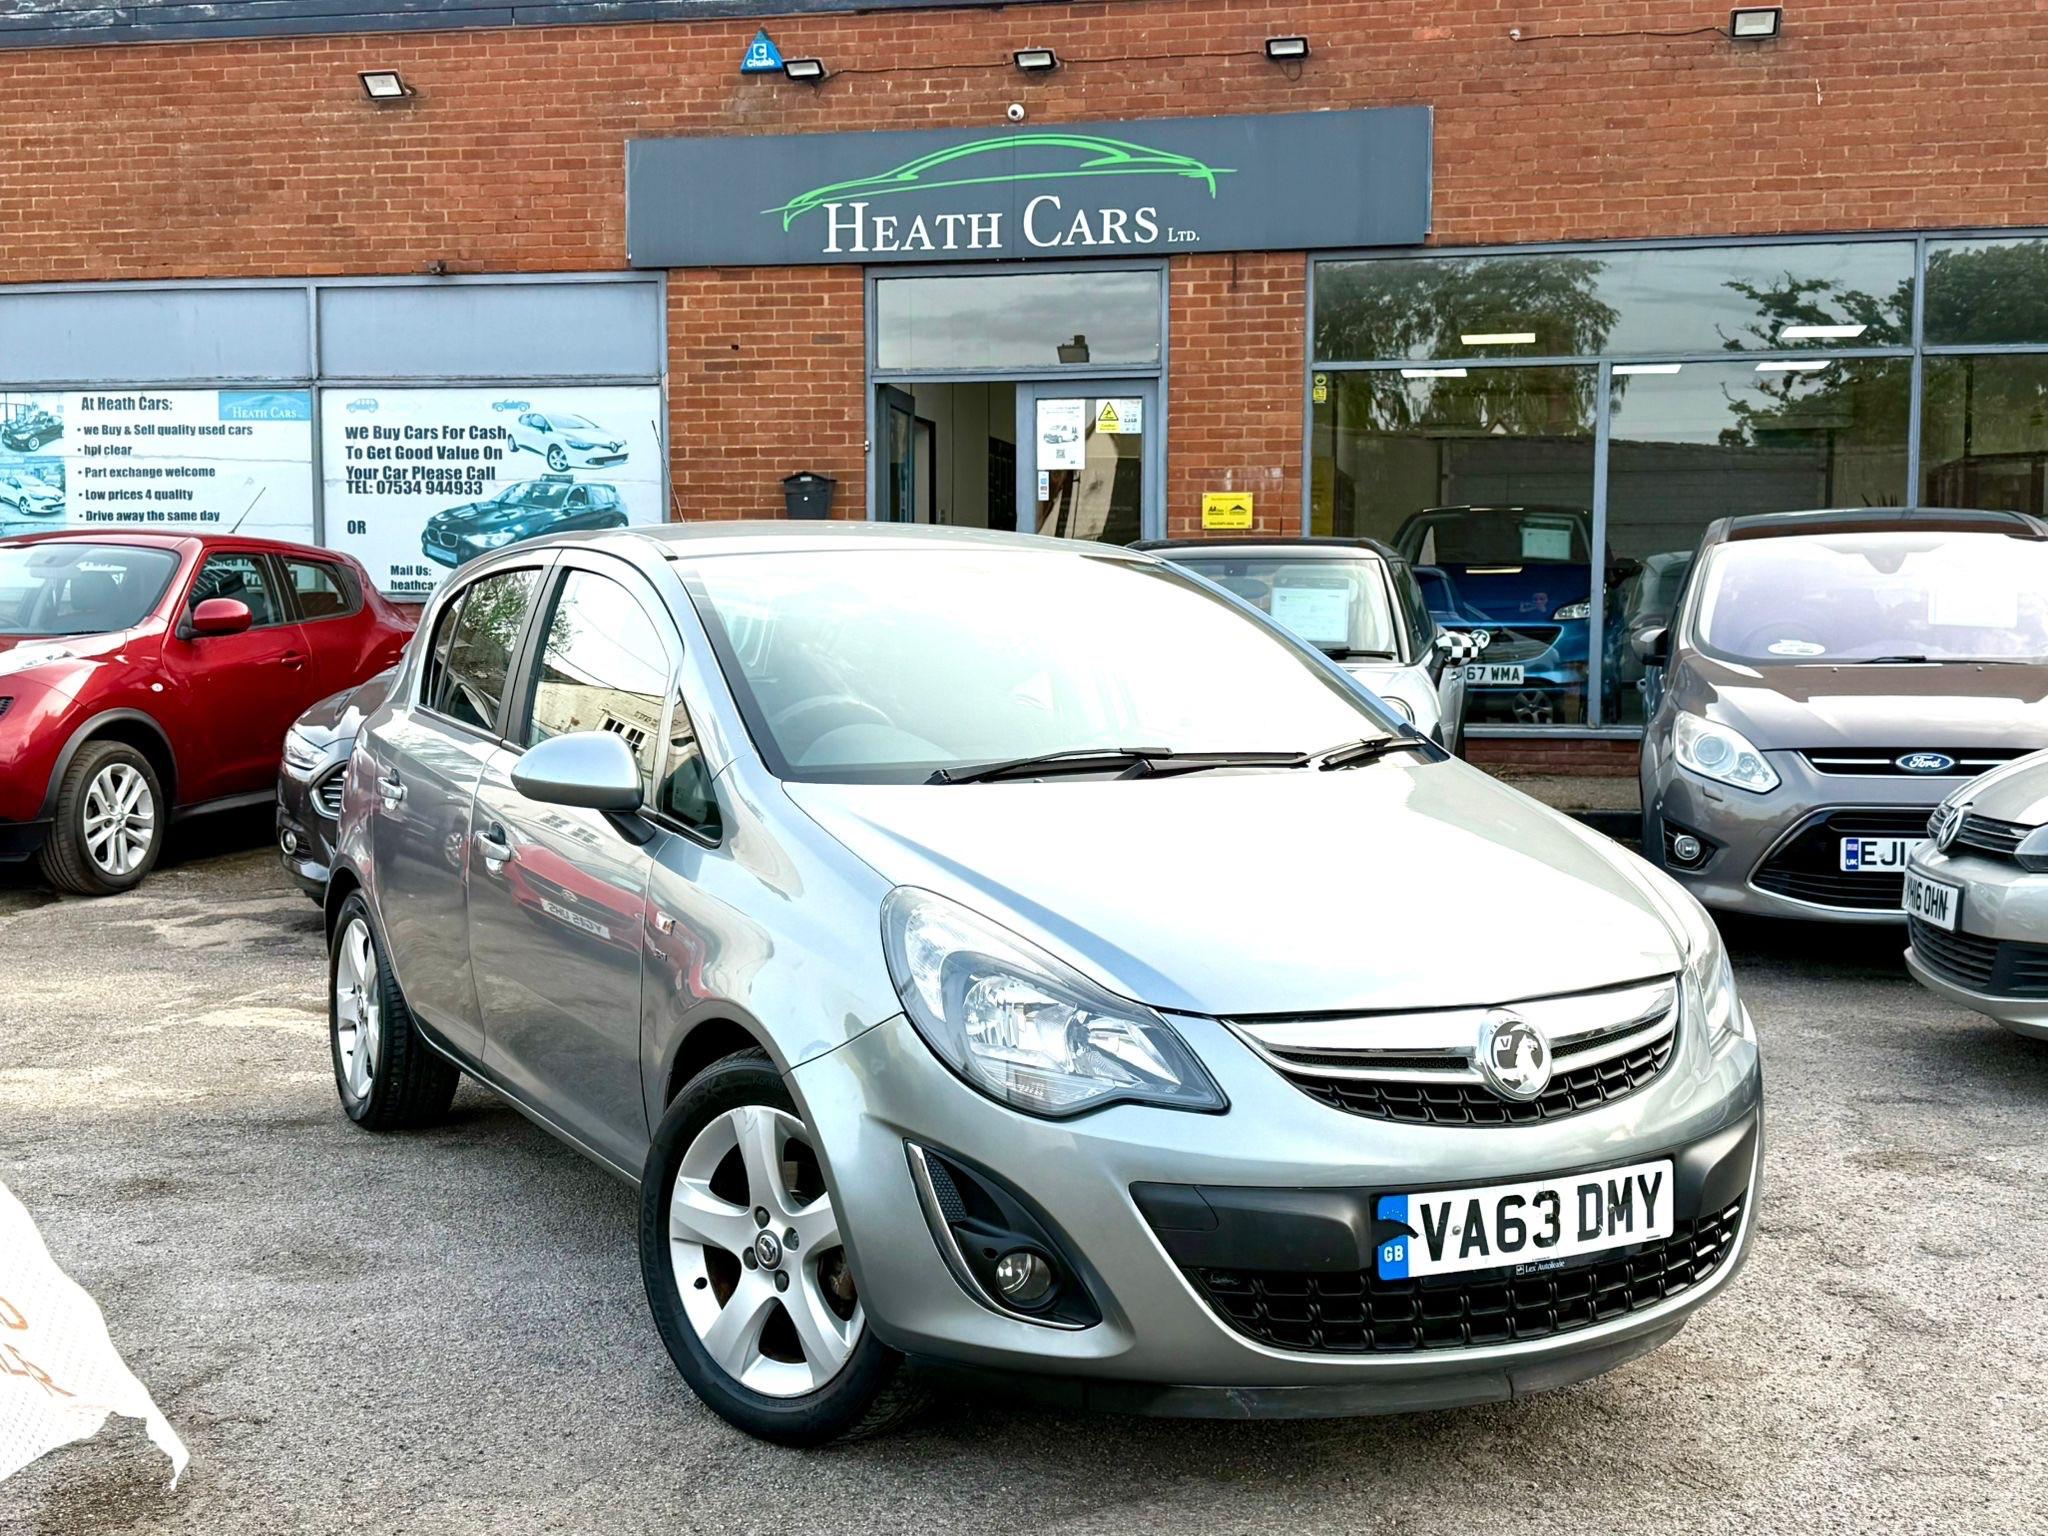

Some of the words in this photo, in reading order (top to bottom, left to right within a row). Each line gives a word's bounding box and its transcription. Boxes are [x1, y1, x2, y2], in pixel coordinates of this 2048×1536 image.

[822, 202, 1002, 253] HEATH
[1023, 195, 1158, 247] CARS
[81, 396, 94, 411] At
[98, 396, 136, 411] Heath
[139, 396, 173, 411] Cars:
[232, 406, 267, 419] HEATH
[270, 406, 297, 419] CARS
[84, 426, 99, 436] we
[102, 424, 122, 437] Buy
[124, 425, 132, 435] &
[134, 424, 155, 436] Sell
[157, 424, 196, 437] quality
[198, 424, 226, 436] used
[228, 426, 253, 436] cars
[373, 425, 400, 441] Buy
[404, 425, 438, 440] Cars
[442, 425, 465, 440] For
[468, 425, 507, 440] Cash
[104, 445, 132, 456] clear
[345, 445, 363, 460] To
[366, 445, 392, 460] Get
[395, 445, 433, 460] Good
[436, 445, 480, 460] Value
[483, 445, 503, 460] On
[85, 467, 107, 478] Part
[109, 466, 163, 479] exchange
[165, 466, 216, 477] welcome
[346, 465, 379, 480] Your
[382, 465, 408, 480] Car
[412, 465, 462, 480] Please
[466, 465, 496, 480] Call
[85, 489, 106, 500] Low
[108, 489, 143, 501] prices
[145, 489, 152, 500] 4
[154, 489, 193, 501] quality
[346, 480, 373, 494] TEL:
[376, 480, 422, 495] 07534
[425, 480, 483, 495] 944933
[86, 510, 114, 521] Drive
[116, 511, 144, 522] away
[147, 510, 165, 521] the
[167, 511, 197, 521] same
[200, 510, 220, 522] day
[347, 520, 366, 535] OR
[390, 565, 413, 576] Mail
[415, 565, 432, 576] Us:
[1490, 666, 1520, 681] WMA
[1909, 755, 1942, 768] Ford
[1860, 841, 1923, 866] EJ1
[1924, 884, 1948, 922] OHN
[1420, 1190, 1561, 1261] VA63
[1577, 1171, 1663, 1242] DMY
[1383, 1245, 1404, 1263] GB
[1525, 1264, 1537, 1273] Lex
